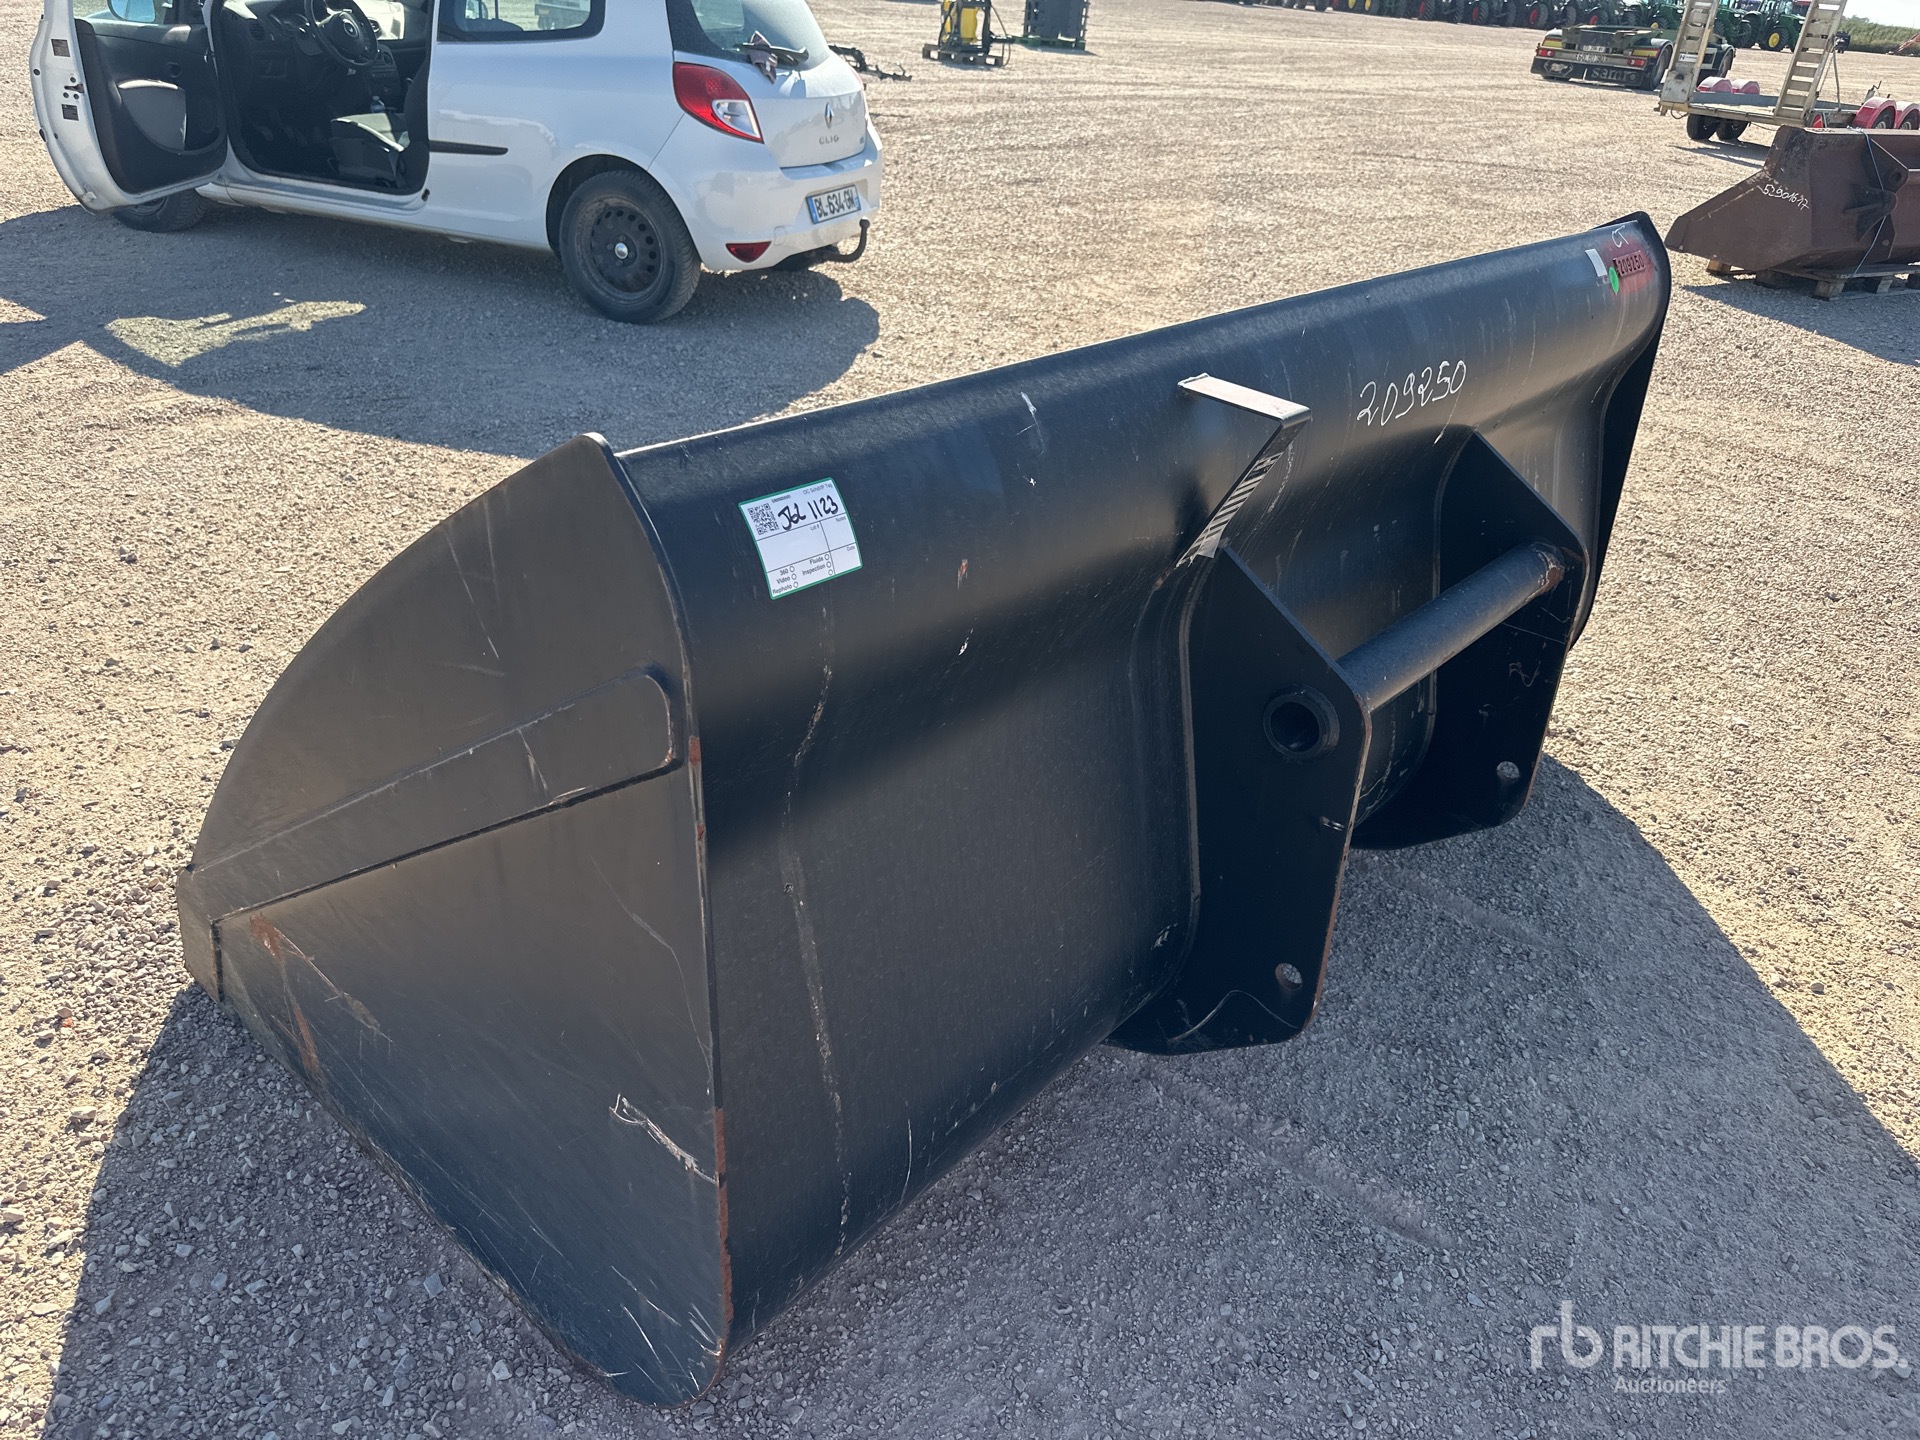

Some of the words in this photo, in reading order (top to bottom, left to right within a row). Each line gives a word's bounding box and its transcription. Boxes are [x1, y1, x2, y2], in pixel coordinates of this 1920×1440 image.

[819, 134, 839, 145] CLIO
[1618, 254, 1645, 275] 209250
[1356, 360, 1467, 427] 209250
[807, 495, 839, 519] 1123
[809, 556, 824, 564] Fluids
[779, 568, 789, 576] 360
[802, 563, 826, 575] Inspection
[776, 576, 790, 584] Video
[772, 584, 793, 595] Rephoto
